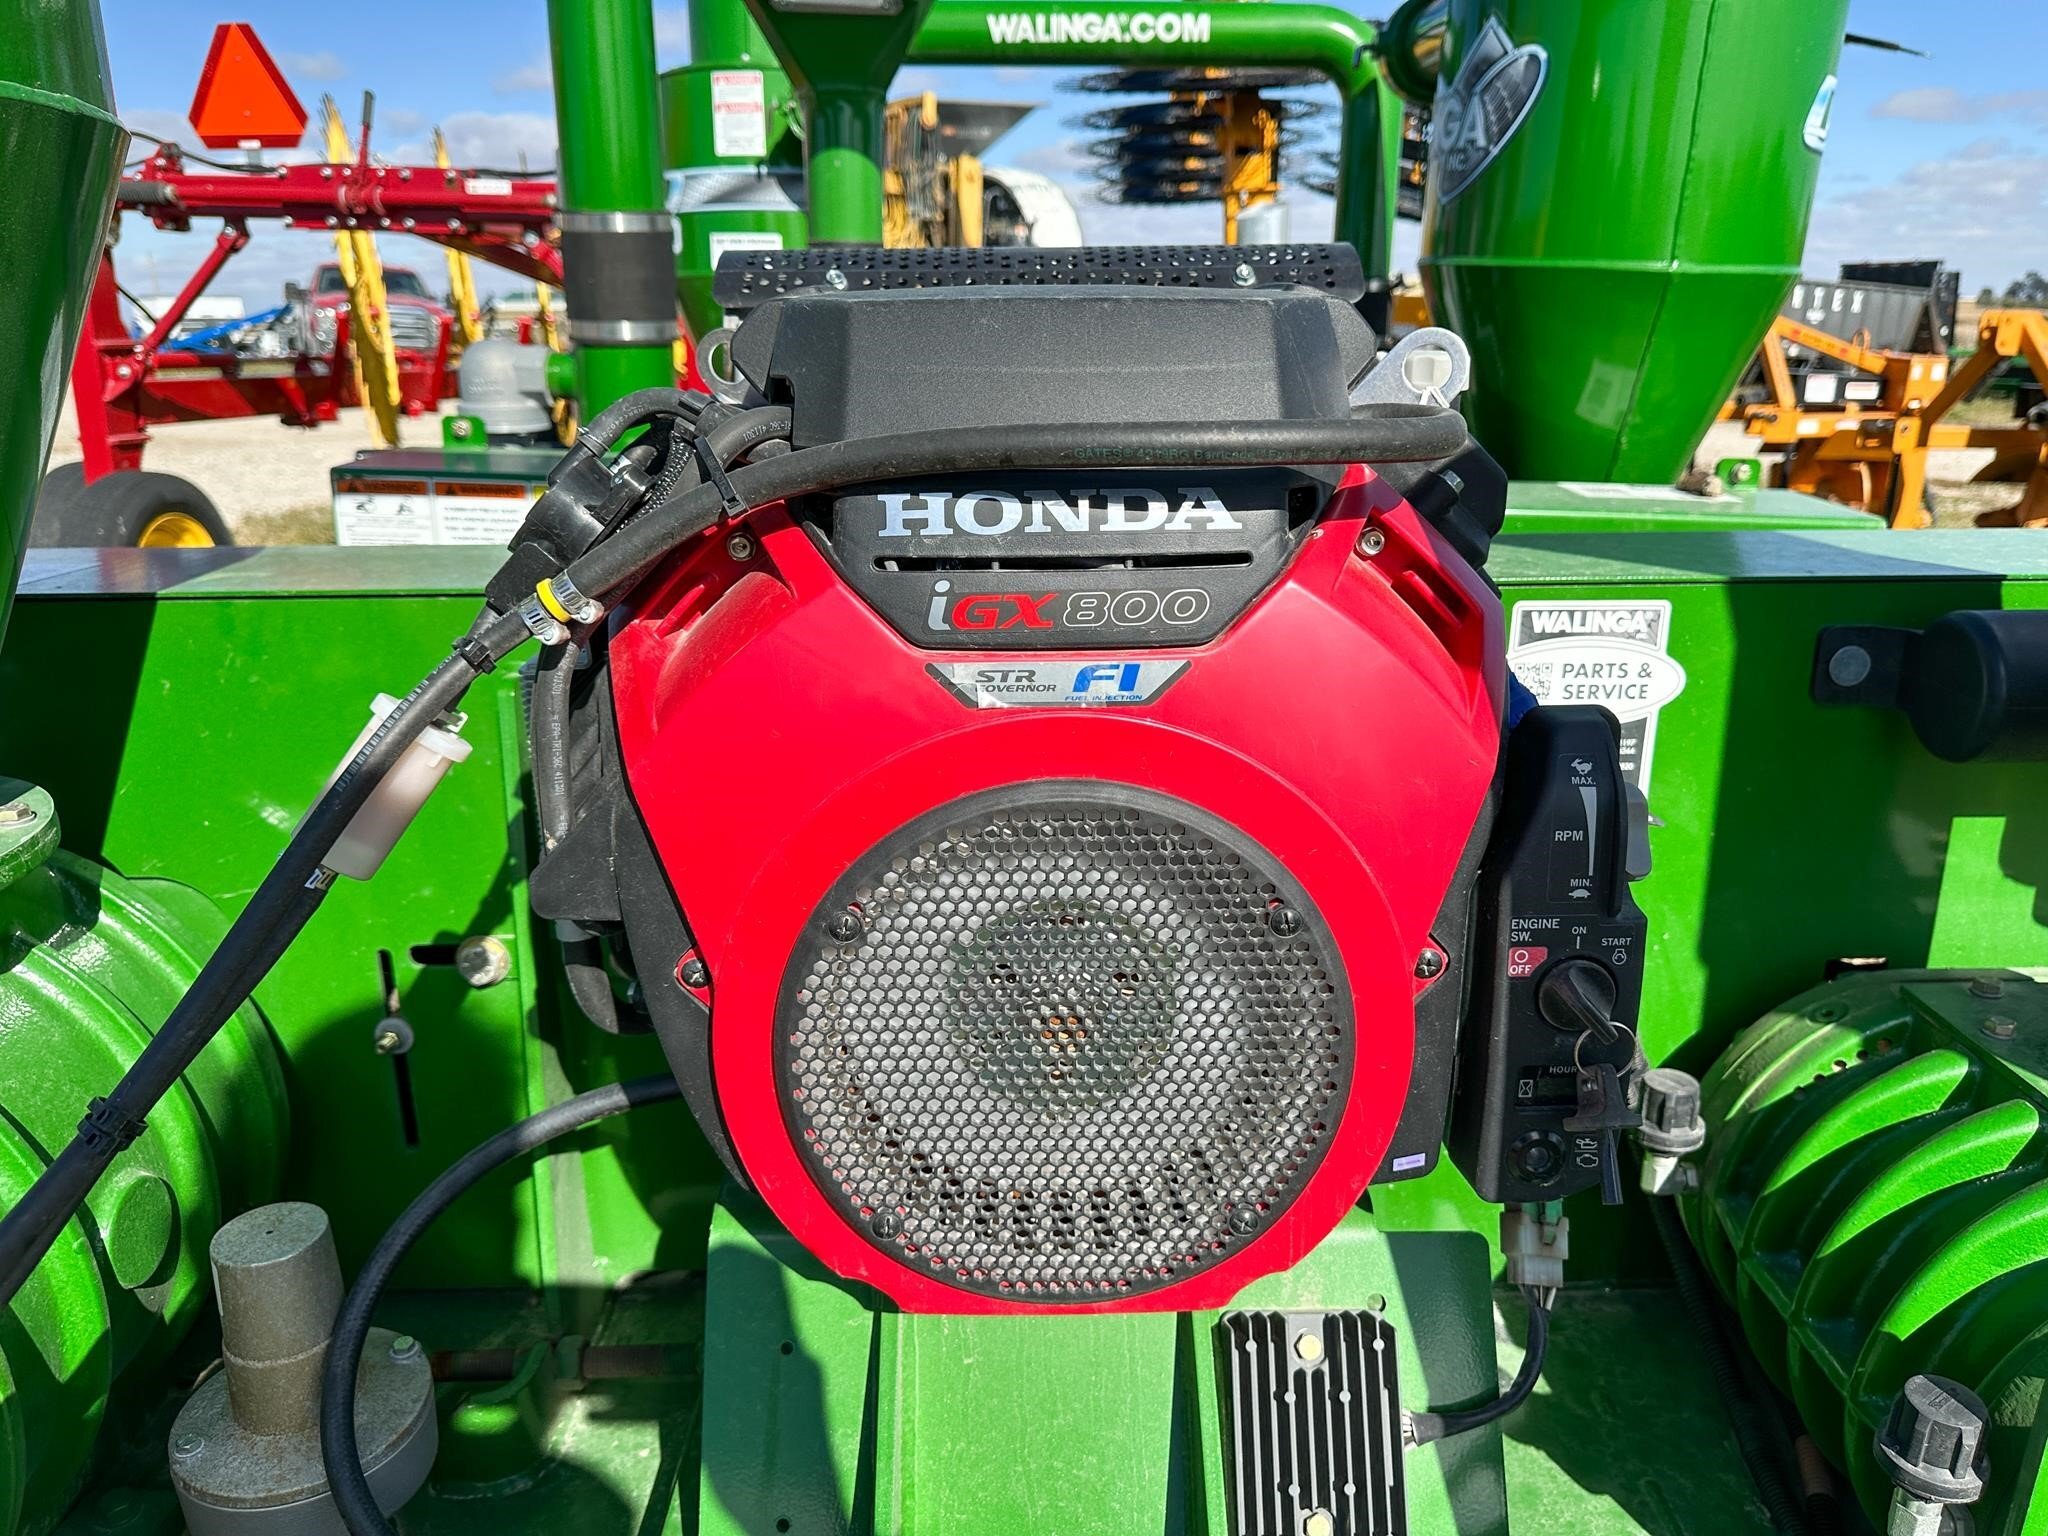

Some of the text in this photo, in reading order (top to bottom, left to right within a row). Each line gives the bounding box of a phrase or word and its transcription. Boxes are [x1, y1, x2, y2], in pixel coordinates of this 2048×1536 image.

[877, 486, 1243, 537] HONDA
[1561, 662, 1653, 679] PARTS &
[975, 663, 1141, 692] STR FI
[1562, 683, 1650, 700] SERVICE
[1064, 693, 1143, 702] FUEL INJECTION
[1571, 776, 1597, 786] MAX.
[1554, 830, 1584, 842] RPM
[1570, 878, 1593, 887] MIN.
[1511, 918, 1561, 929] ENGINE
[1571, 925, 1587, 935] ON
[1510, 931, 1532, 942] SW.
[1601, 937, 1632, 946] START
[1509, 964, 1532, 975] OFF
